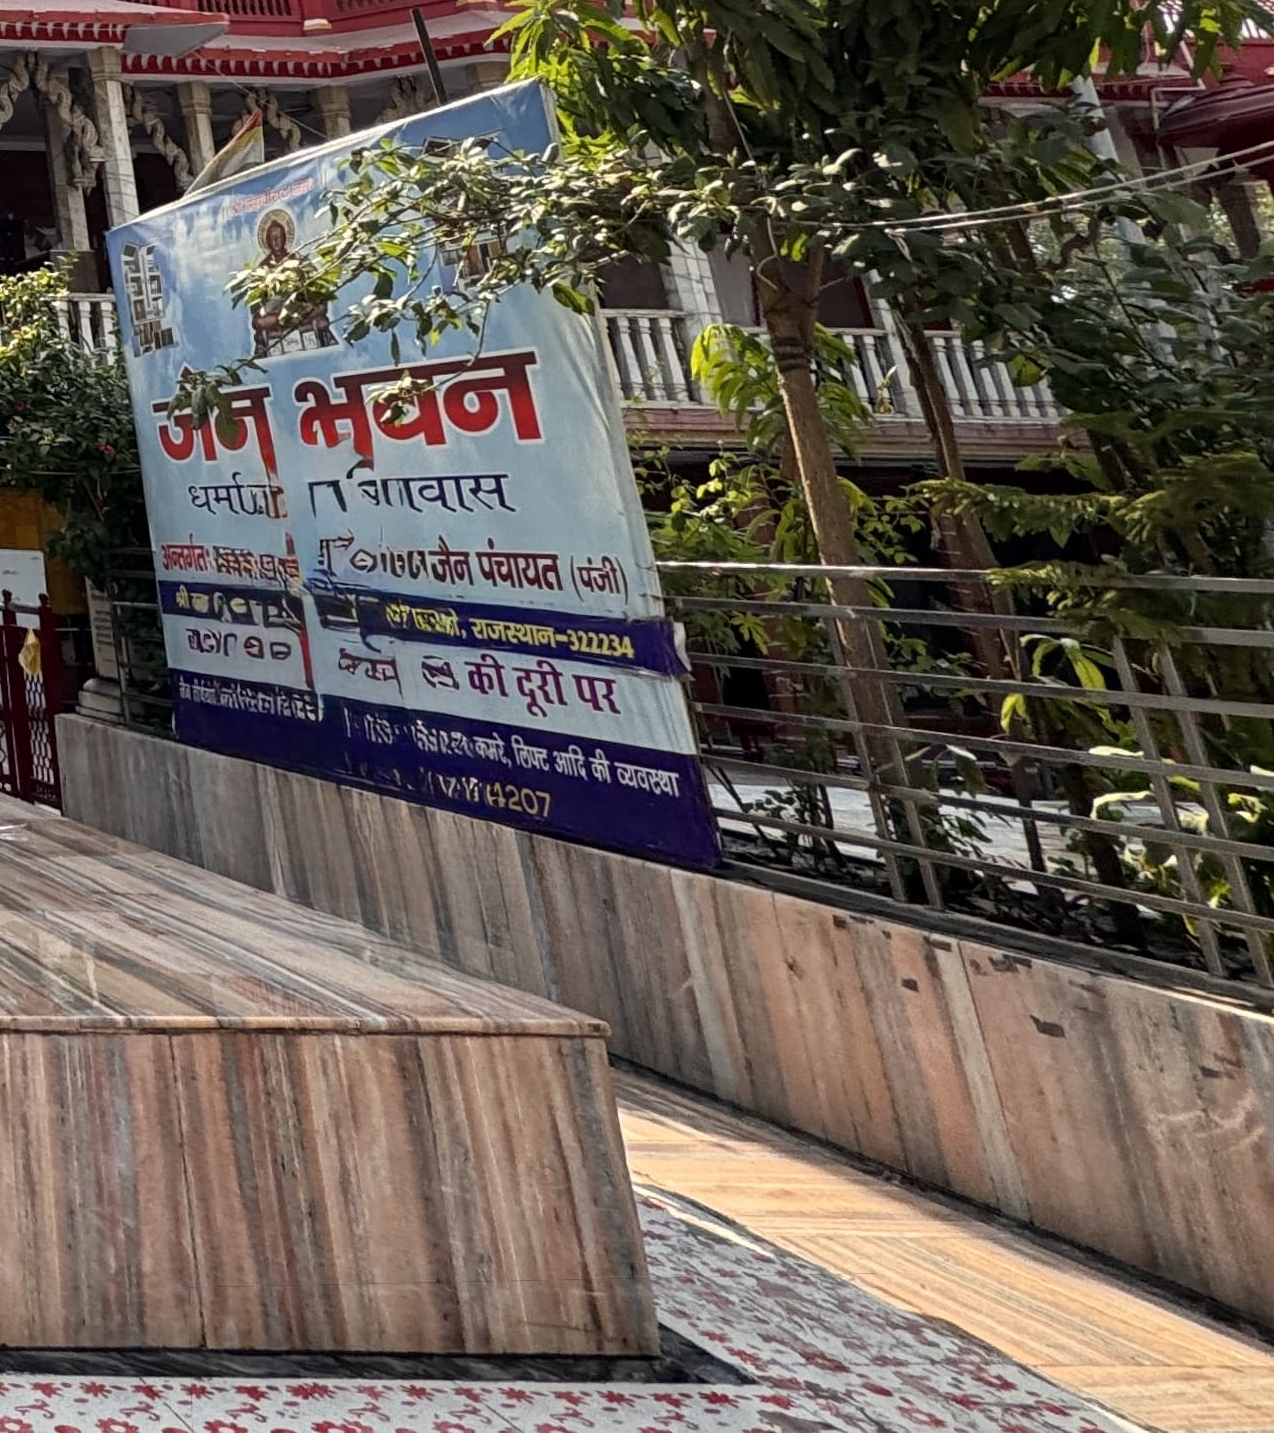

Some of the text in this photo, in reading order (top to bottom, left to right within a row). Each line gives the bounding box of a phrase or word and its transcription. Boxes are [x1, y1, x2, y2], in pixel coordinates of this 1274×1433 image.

[294, 350, 543, 462] भवन
[428, 534, 474, 586] जैन
[475, 537, 564, 591] पंचायत
[570, 554, 629, 603] (पंजी)
[464, 653, 509, 698] की
[513, 660, 567, 717] दूरी
[572, 674, 622, 715] पर
[474, 732, 512, 768] कमरे,
[512, 735, 551, 772] लिफ्ट
[554, 746, 588, 782] आदि
[589, 751, 612, 784] की
[616, 761, 679, 799] व्यवस्था
